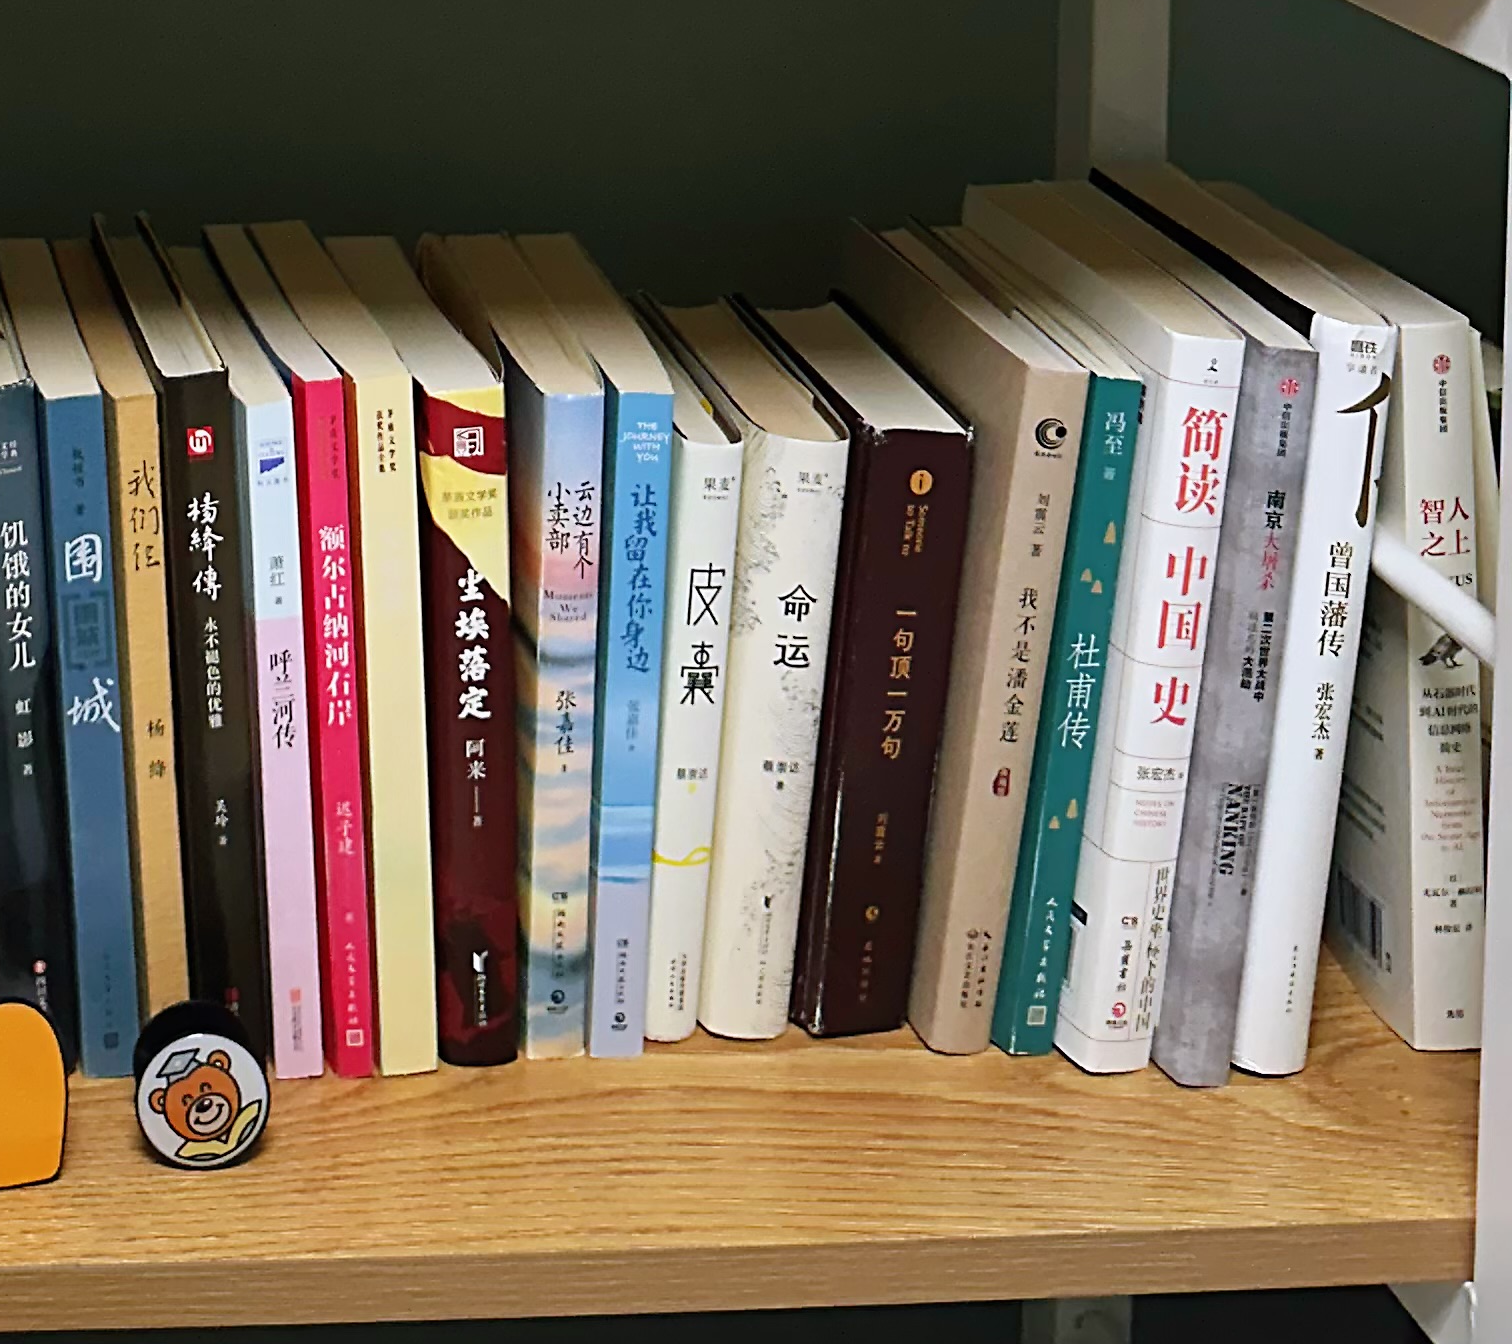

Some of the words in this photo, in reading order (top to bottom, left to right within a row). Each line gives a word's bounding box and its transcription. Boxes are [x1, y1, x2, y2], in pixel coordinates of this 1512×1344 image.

[1104, 411, 1127, 456] 冯至
[545, 481, 572, 554] 小卖部
[1260, 489, 1287, 593] 南京大屠杀
[1419, 496, 1471, 526] 智人
[1420, 531, 1471, 559] 之上
[0, 519, 37, 672] 饥饿的女儿
[317, 524, 352, 727] 额尔古纳河右岸
[620, 483, 658, 673] 让我留在你身边
[773, 583, 817, 669] 命运
[1317, 541, 1354, 658] 曾国藩传
[454, 568, 492, 720] 尘埃落定
[680, 562, 726, 705] 皮囊
[880, 609, 917, 760] 一句顶一万句
[998, 586, 1040, 744] 我不是潘金莲
[268, 649, 297, 750] 呼兰河传
[554, 689, 578, 755] 张嘉佳
[1057, 632, 1102, 750] 杜甫传
[1311, 682, 1335, 740] 张宏杰
